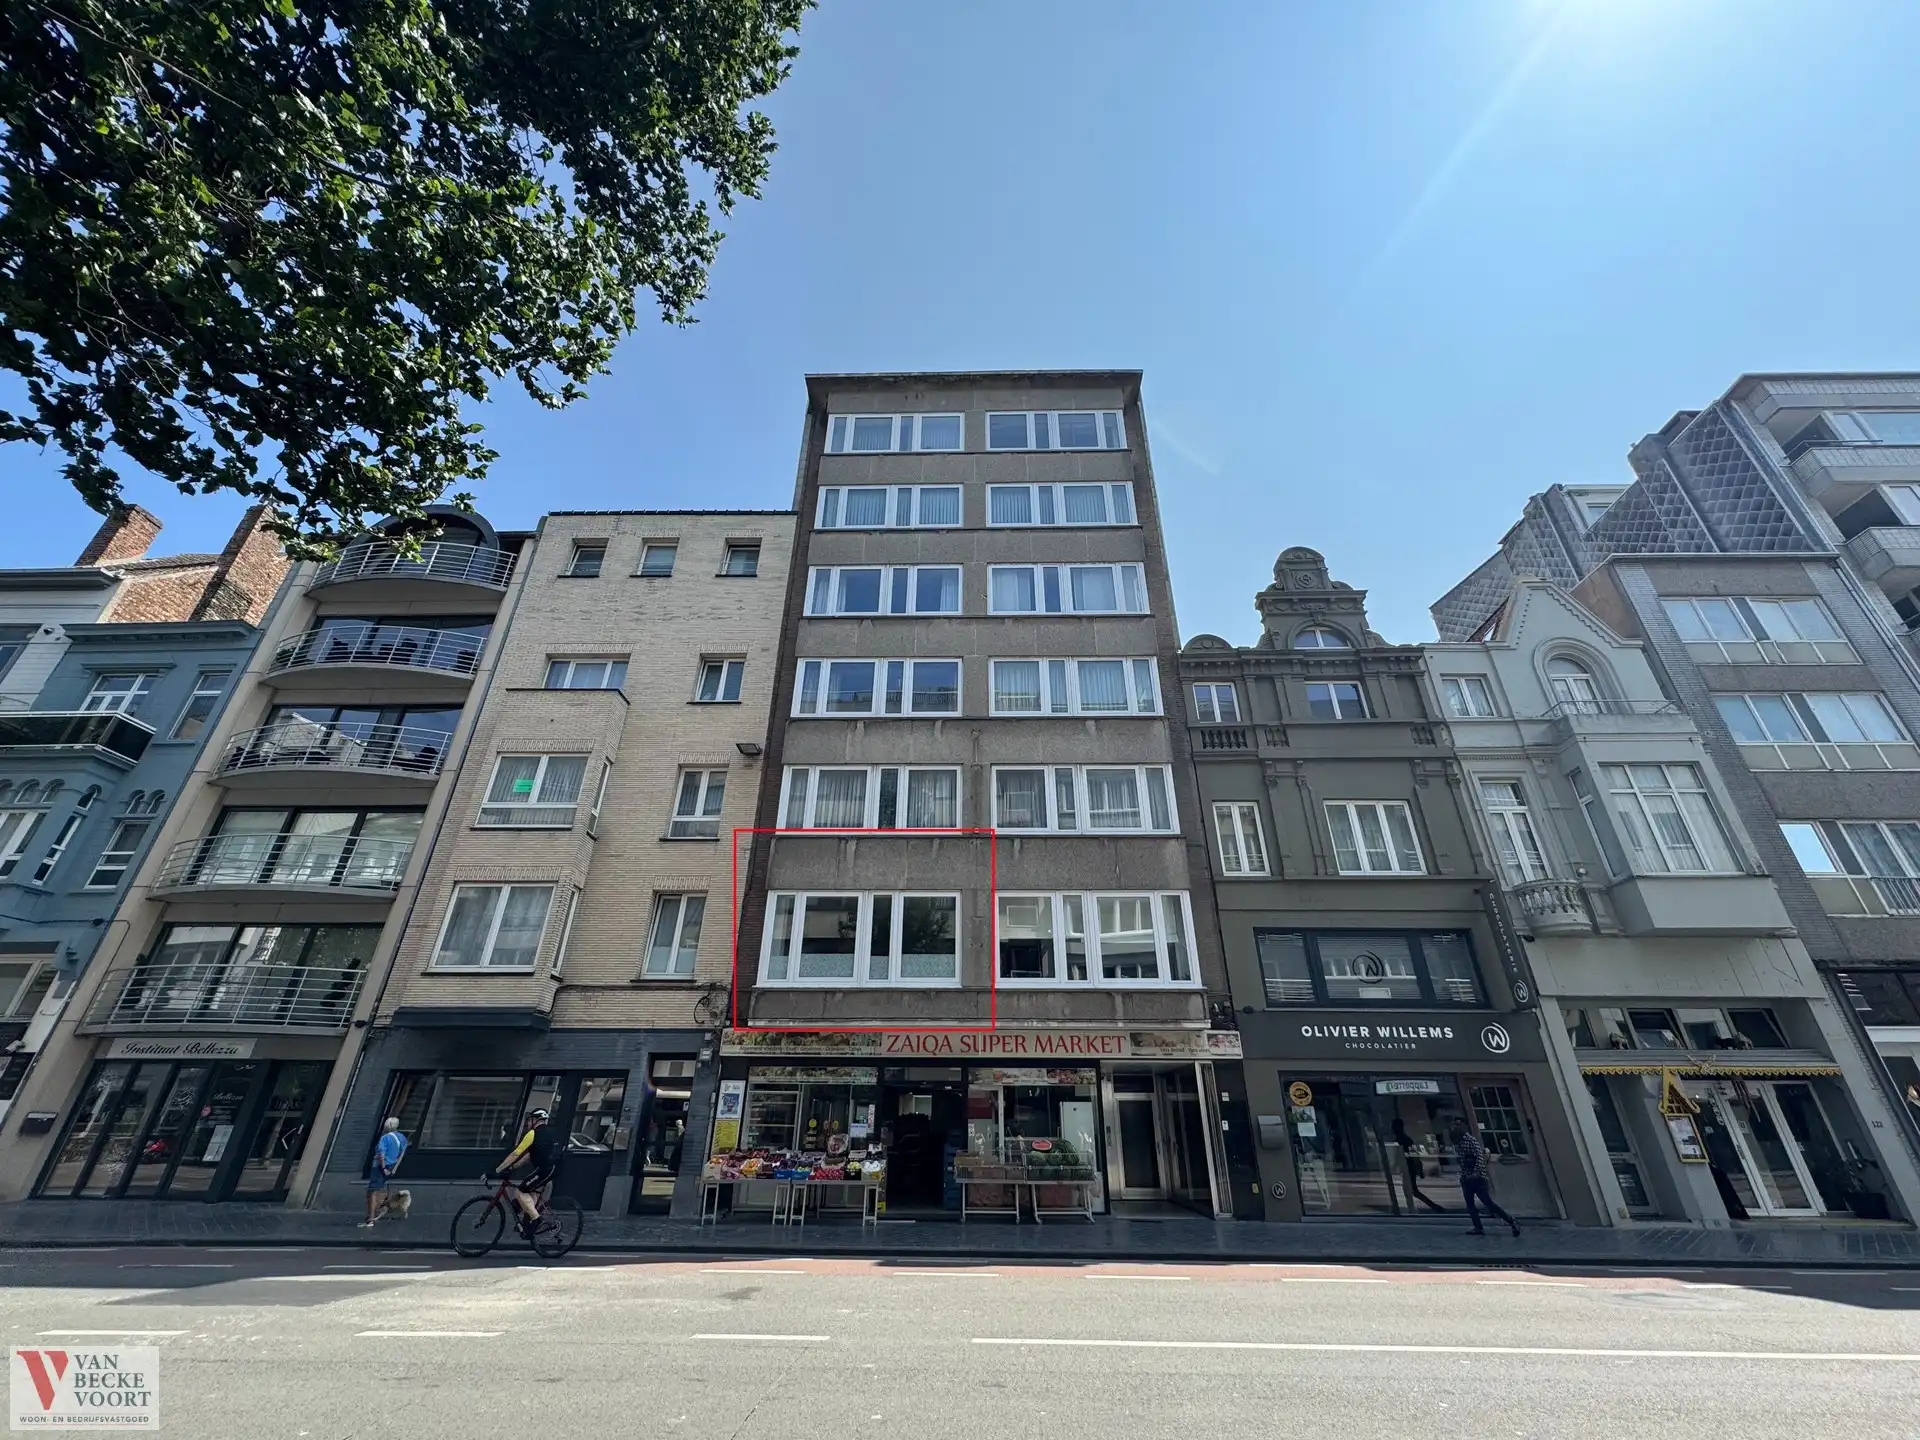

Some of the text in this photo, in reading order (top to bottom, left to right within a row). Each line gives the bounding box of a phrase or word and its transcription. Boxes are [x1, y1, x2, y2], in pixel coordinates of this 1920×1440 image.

[1301, 1025, 1454, 1039] OLIVIER WILLEMS
[182, 1041, 239, 1055] Bellezza
[886, 1034, 1127, 1056] ZAIQA SUPER MARKET
[1345, 1042, 1416, 1050] CHOCOLATIER
